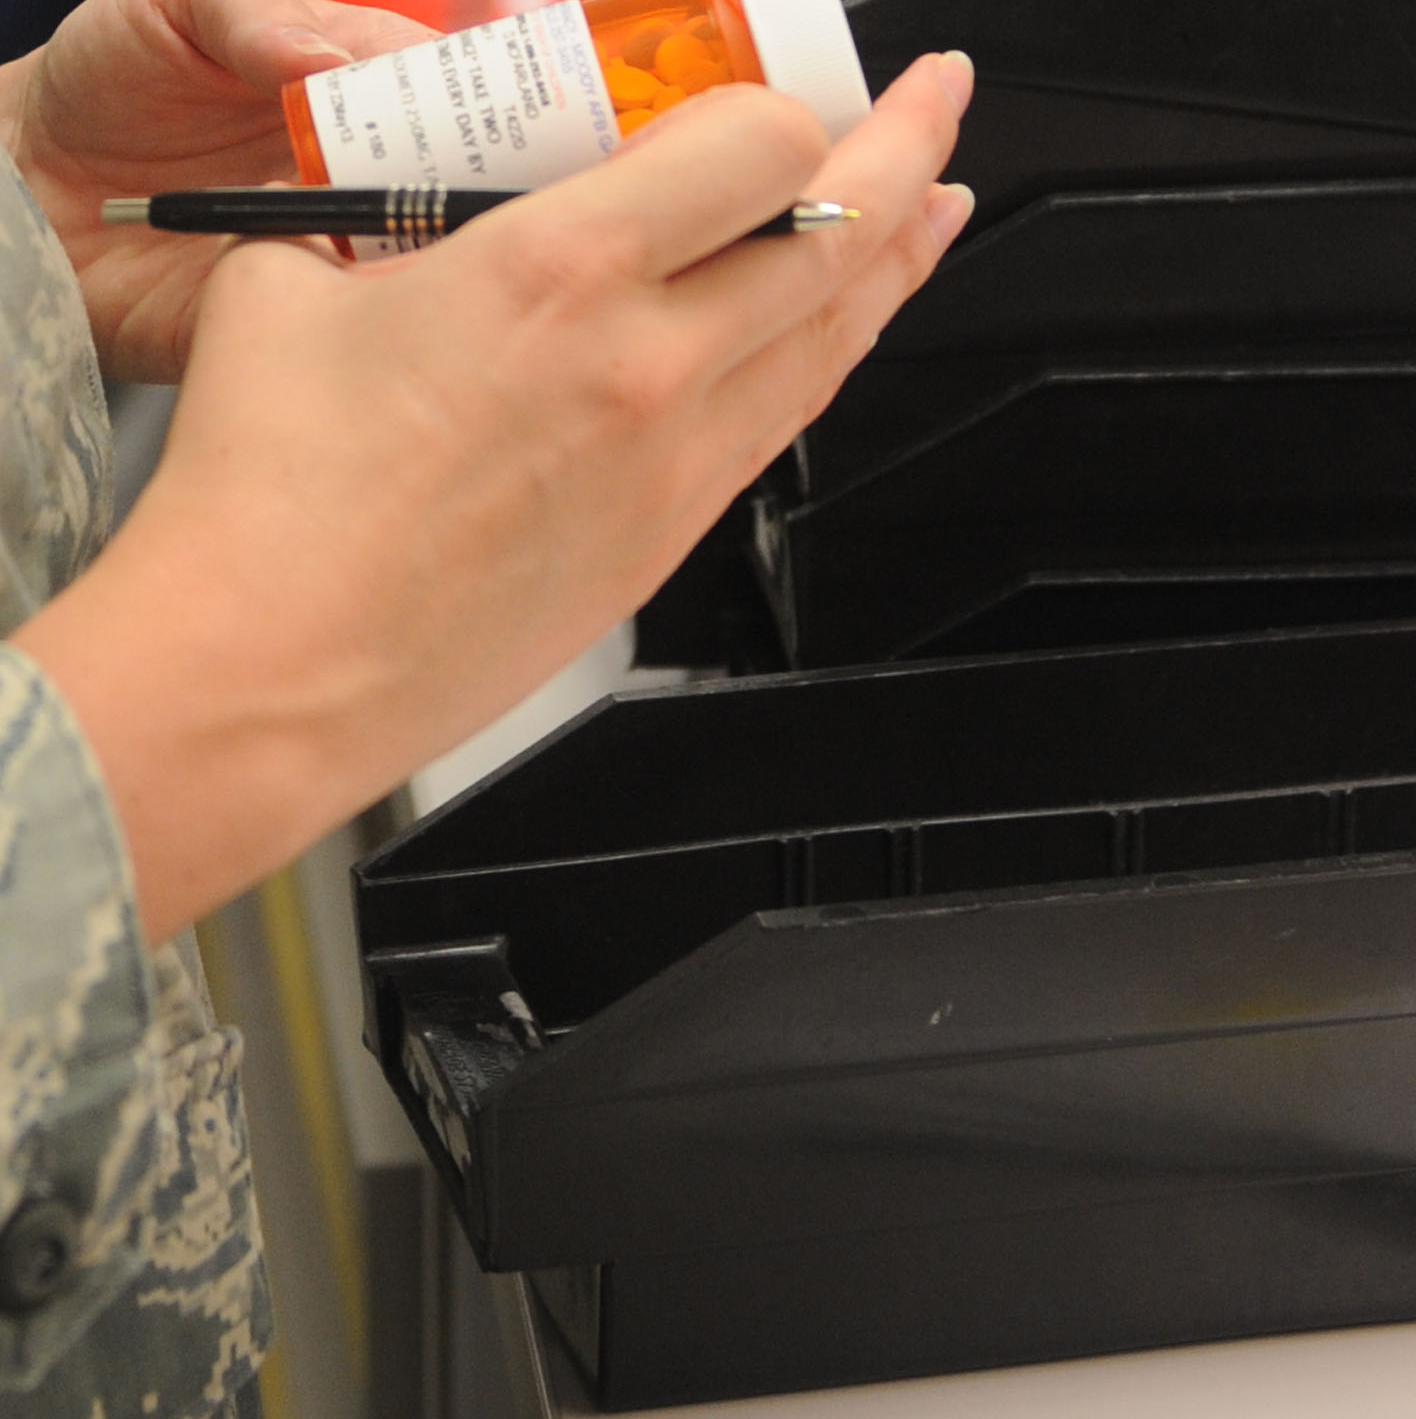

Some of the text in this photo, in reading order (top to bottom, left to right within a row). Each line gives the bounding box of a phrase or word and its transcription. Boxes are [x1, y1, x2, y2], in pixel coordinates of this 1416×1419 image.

[441, 67, 466, 110] EVERY
[455, 112, 477, 148] DAY
[466, 152, 485, 176] BY
[467, 65, 489, 100] TAKE
[479, 105, 501, 145] TWO
[569, 42, 597, 98] MOODY
[586, 98, 607, 132] AFB
[404, 107, 432, 162] 250MG
[502, 104, 526, 151] T4220
